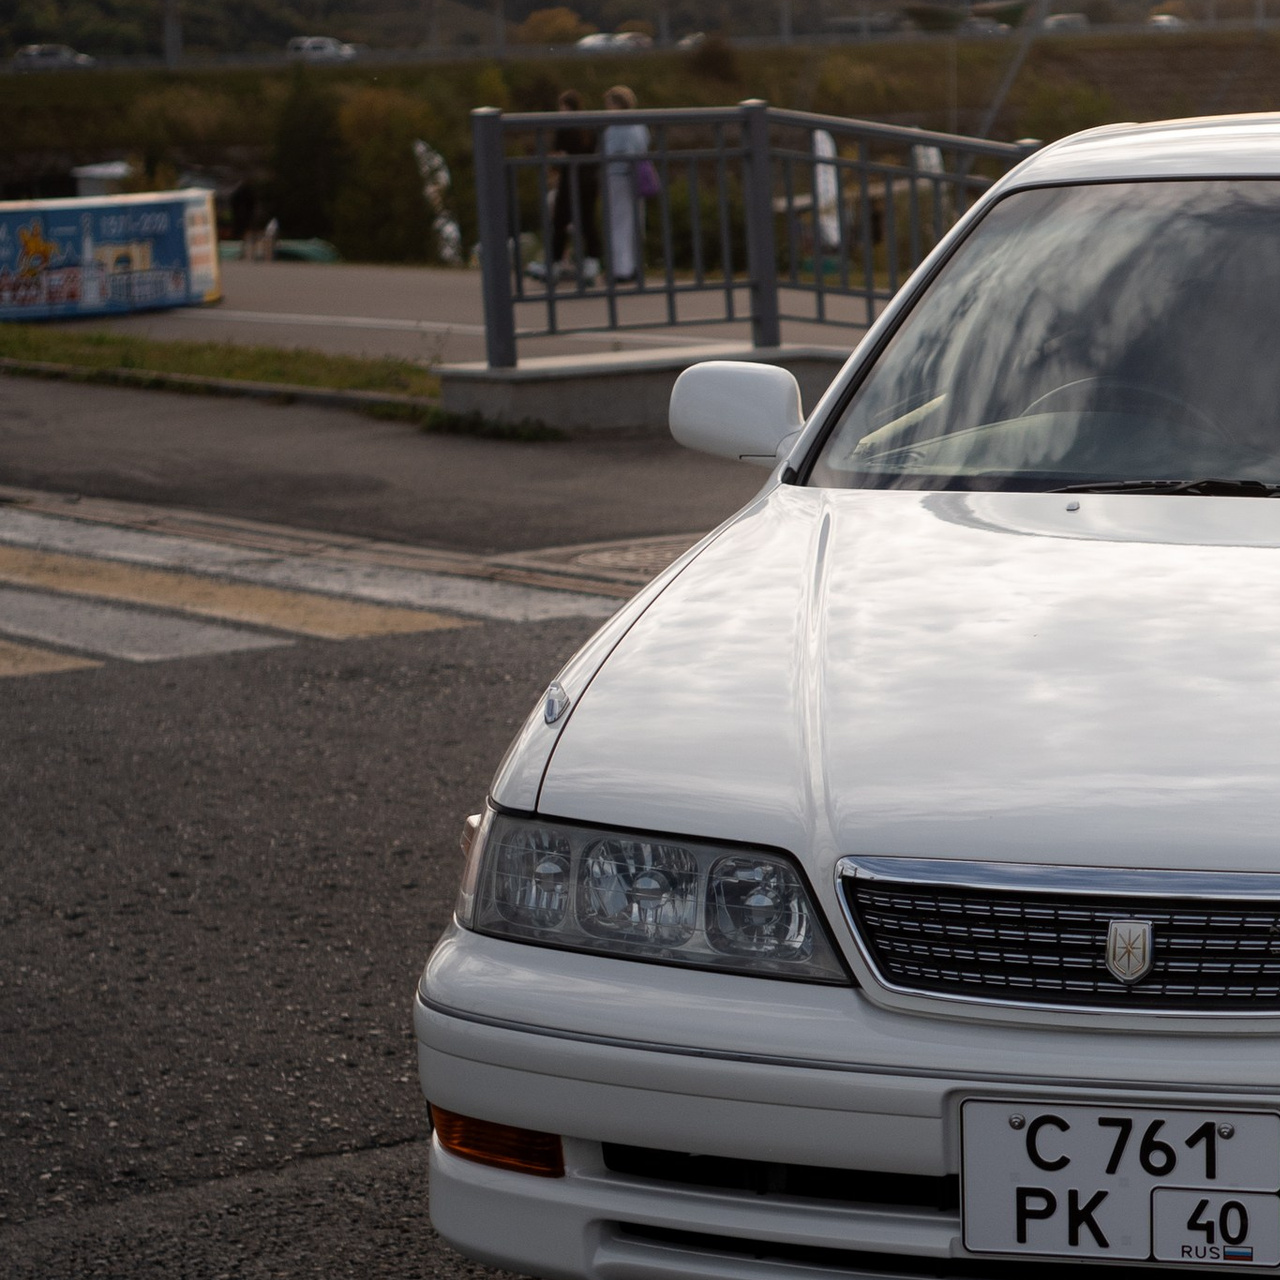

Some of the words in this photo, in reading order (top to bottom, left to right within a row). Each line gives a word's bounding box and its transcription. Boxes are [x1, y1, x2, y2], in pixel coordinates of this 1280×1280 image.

[1098, 1116, 1217, 1179] 761
[1015, 1187, 1109, 1248] РК
[1187, 1199, 1249, 1245] 40
[1181, 1245, 1221, 1260] RUS
